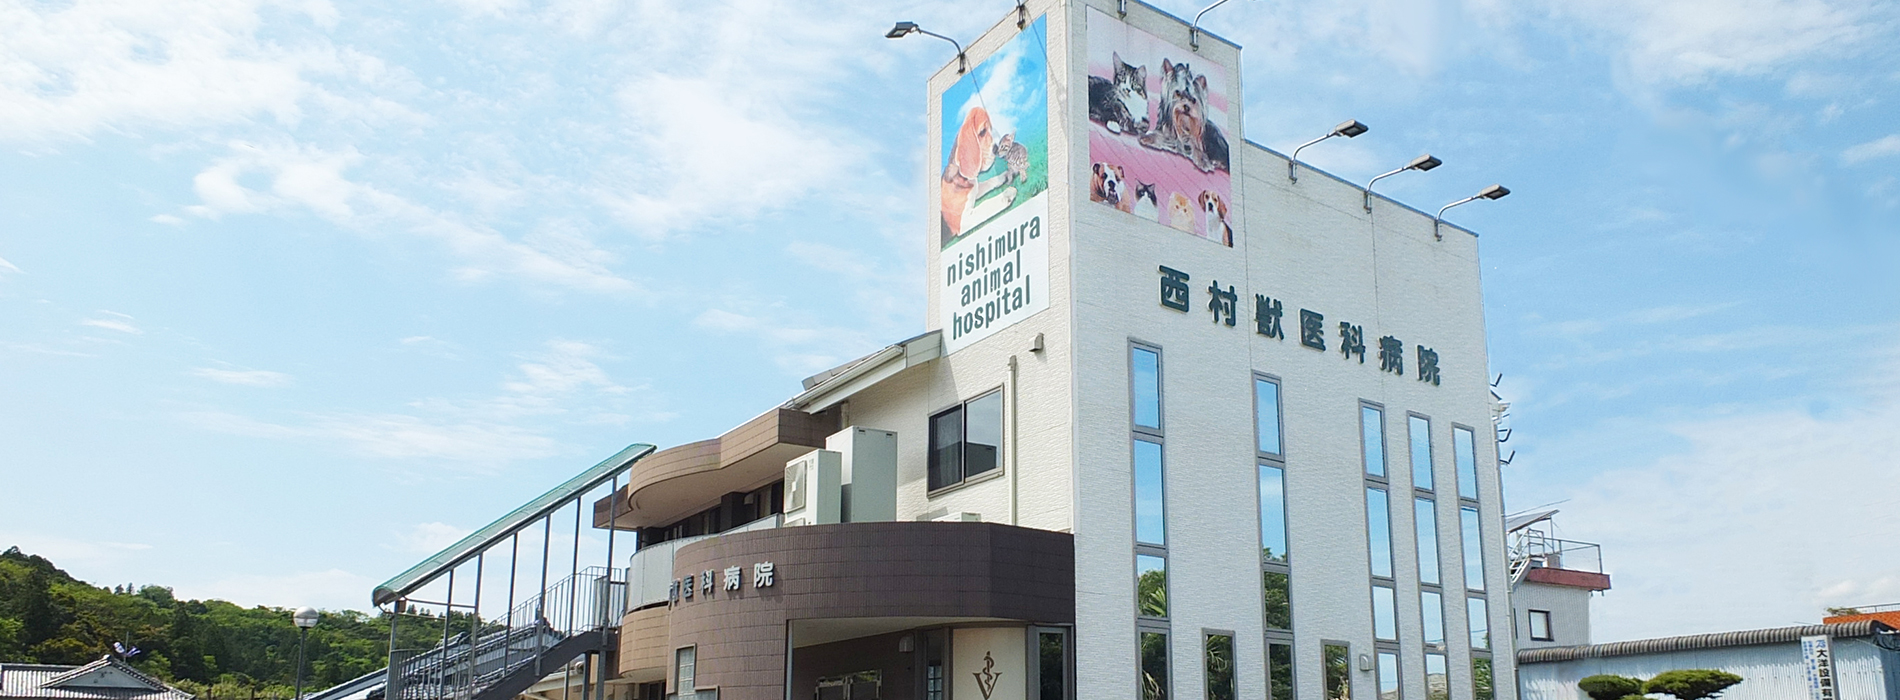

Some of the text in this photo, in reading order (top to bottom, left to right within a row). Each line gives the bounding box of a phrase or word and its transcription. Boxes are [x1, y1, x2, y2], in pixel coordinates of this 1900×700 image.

[947, 216, 1040, 287] nishimura
[961, 249, 1020, 307] animal
[953, 274, 1030, 340] hospital
[1157, 264, 1440, 386] 西村獣医科病院
